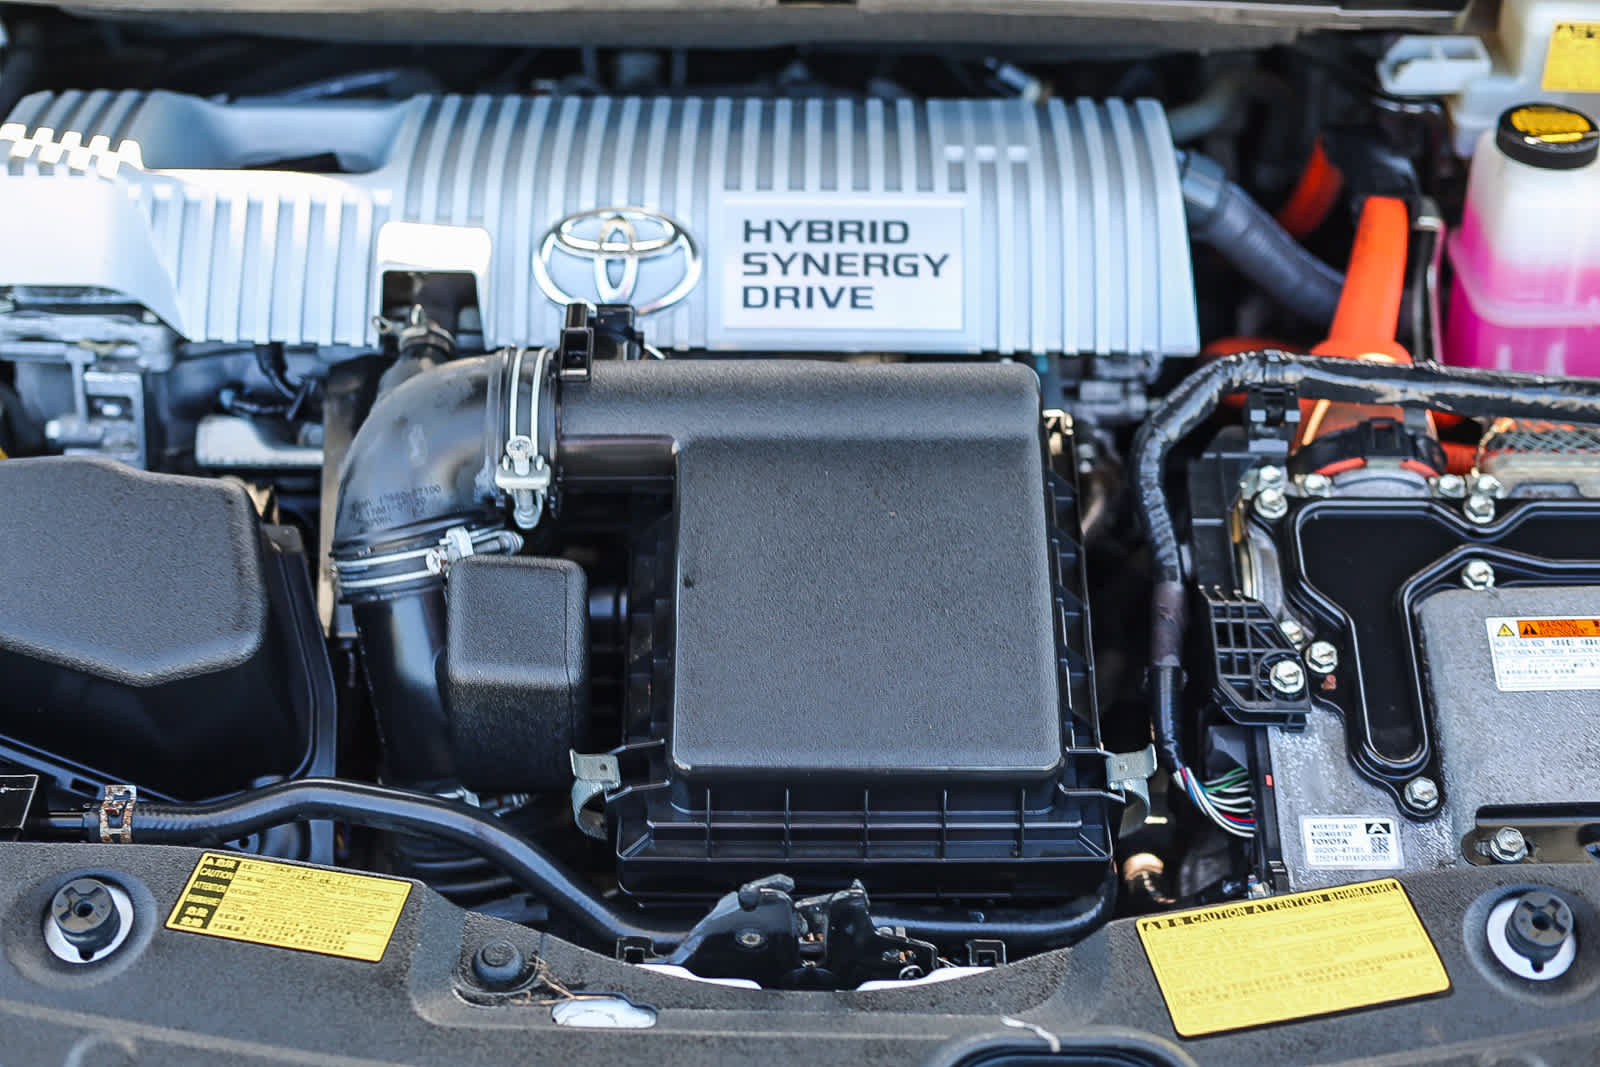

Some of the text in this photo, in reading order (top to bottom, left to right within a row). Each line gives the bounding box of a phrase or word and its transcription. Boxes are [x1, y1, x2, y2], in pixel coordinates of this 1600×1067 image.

[743, 219, 910, 244] HYBRID
[743, 252, 950, 278] SYNERGY
[742, 285, 875, 310] DRIVE
[199, 867, 236, 880] CAUTION
[1191, 907, 1247, 925] CAUTION
[1253, 893, 1323, 914] ATTENTION
